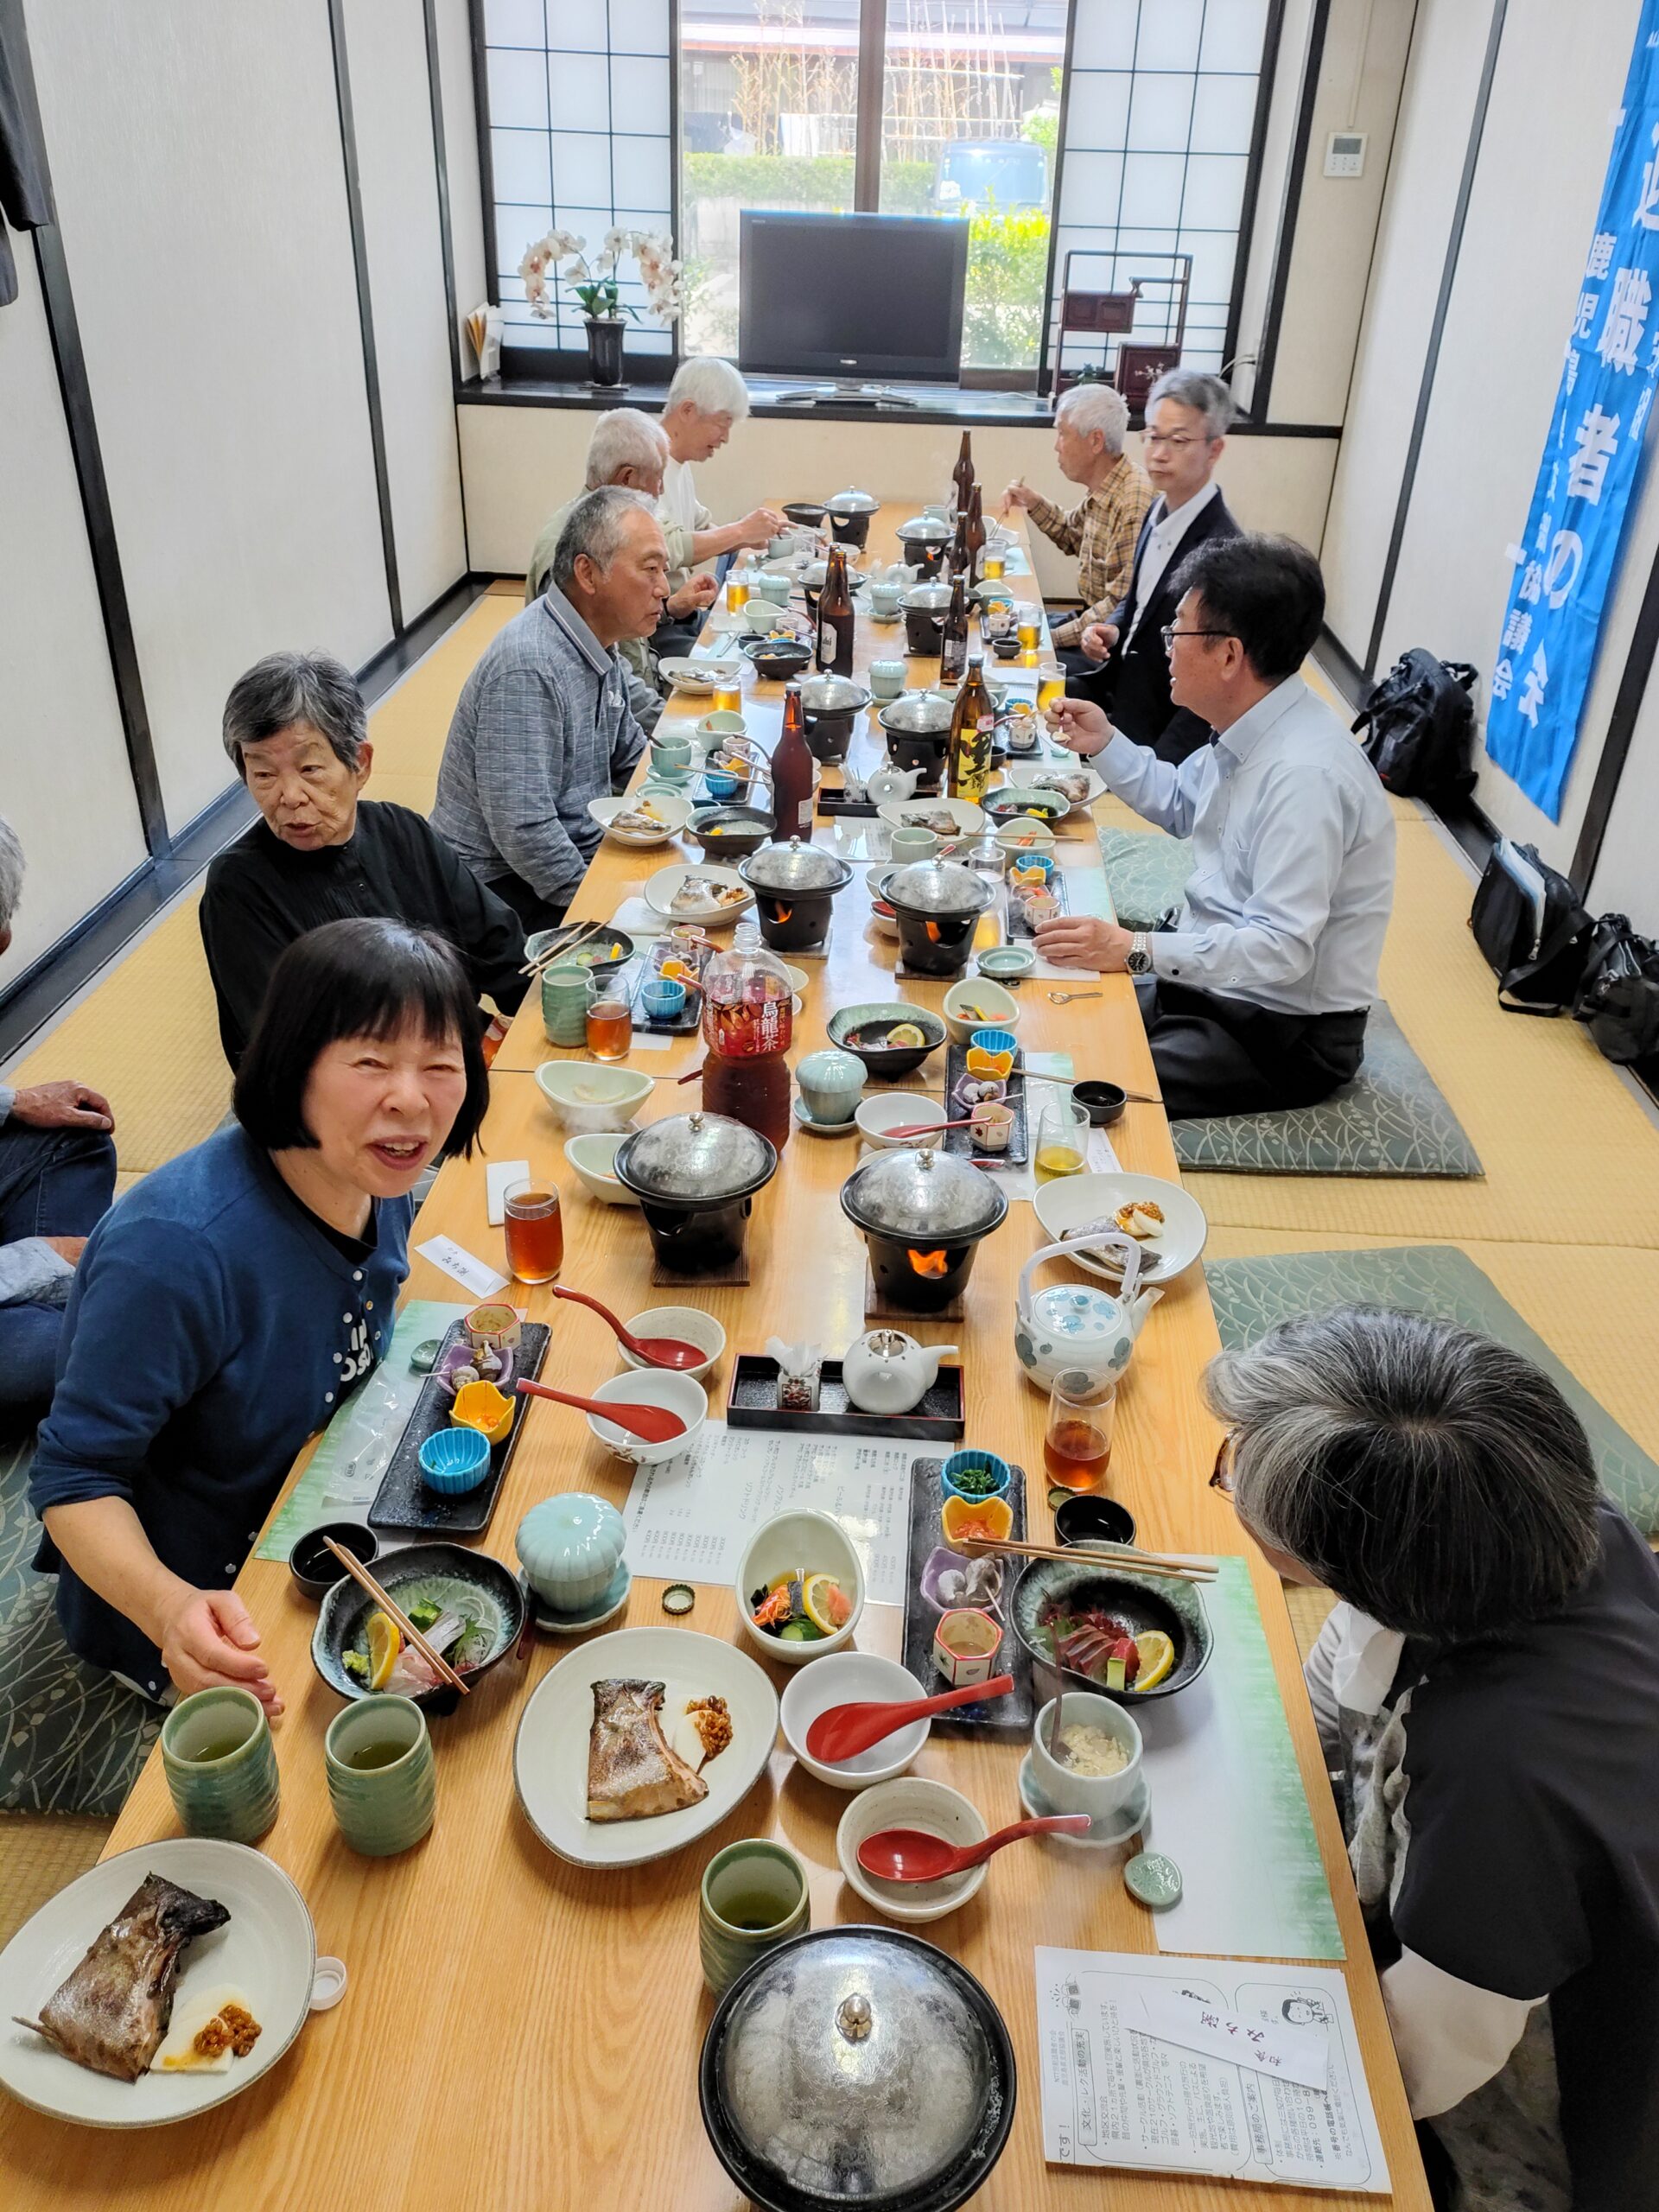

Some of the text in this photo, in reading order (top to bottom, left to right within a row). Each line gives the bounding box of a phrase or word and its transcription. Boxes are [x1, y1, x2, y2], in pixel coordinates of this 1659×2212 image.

[761, 1001, 779, 1052] 烏龍茶
[739, 1481, 753, 1519] ソフトドリンク
[1199, 2011, 1265, 2044] みち潮
[1254, 2049, 1283, 2067] 和食
[1077, 2031, 1092, 2131] 文化・レク活動の充実
[1245, 2083, 1266, 2154] 事務局のご案内
